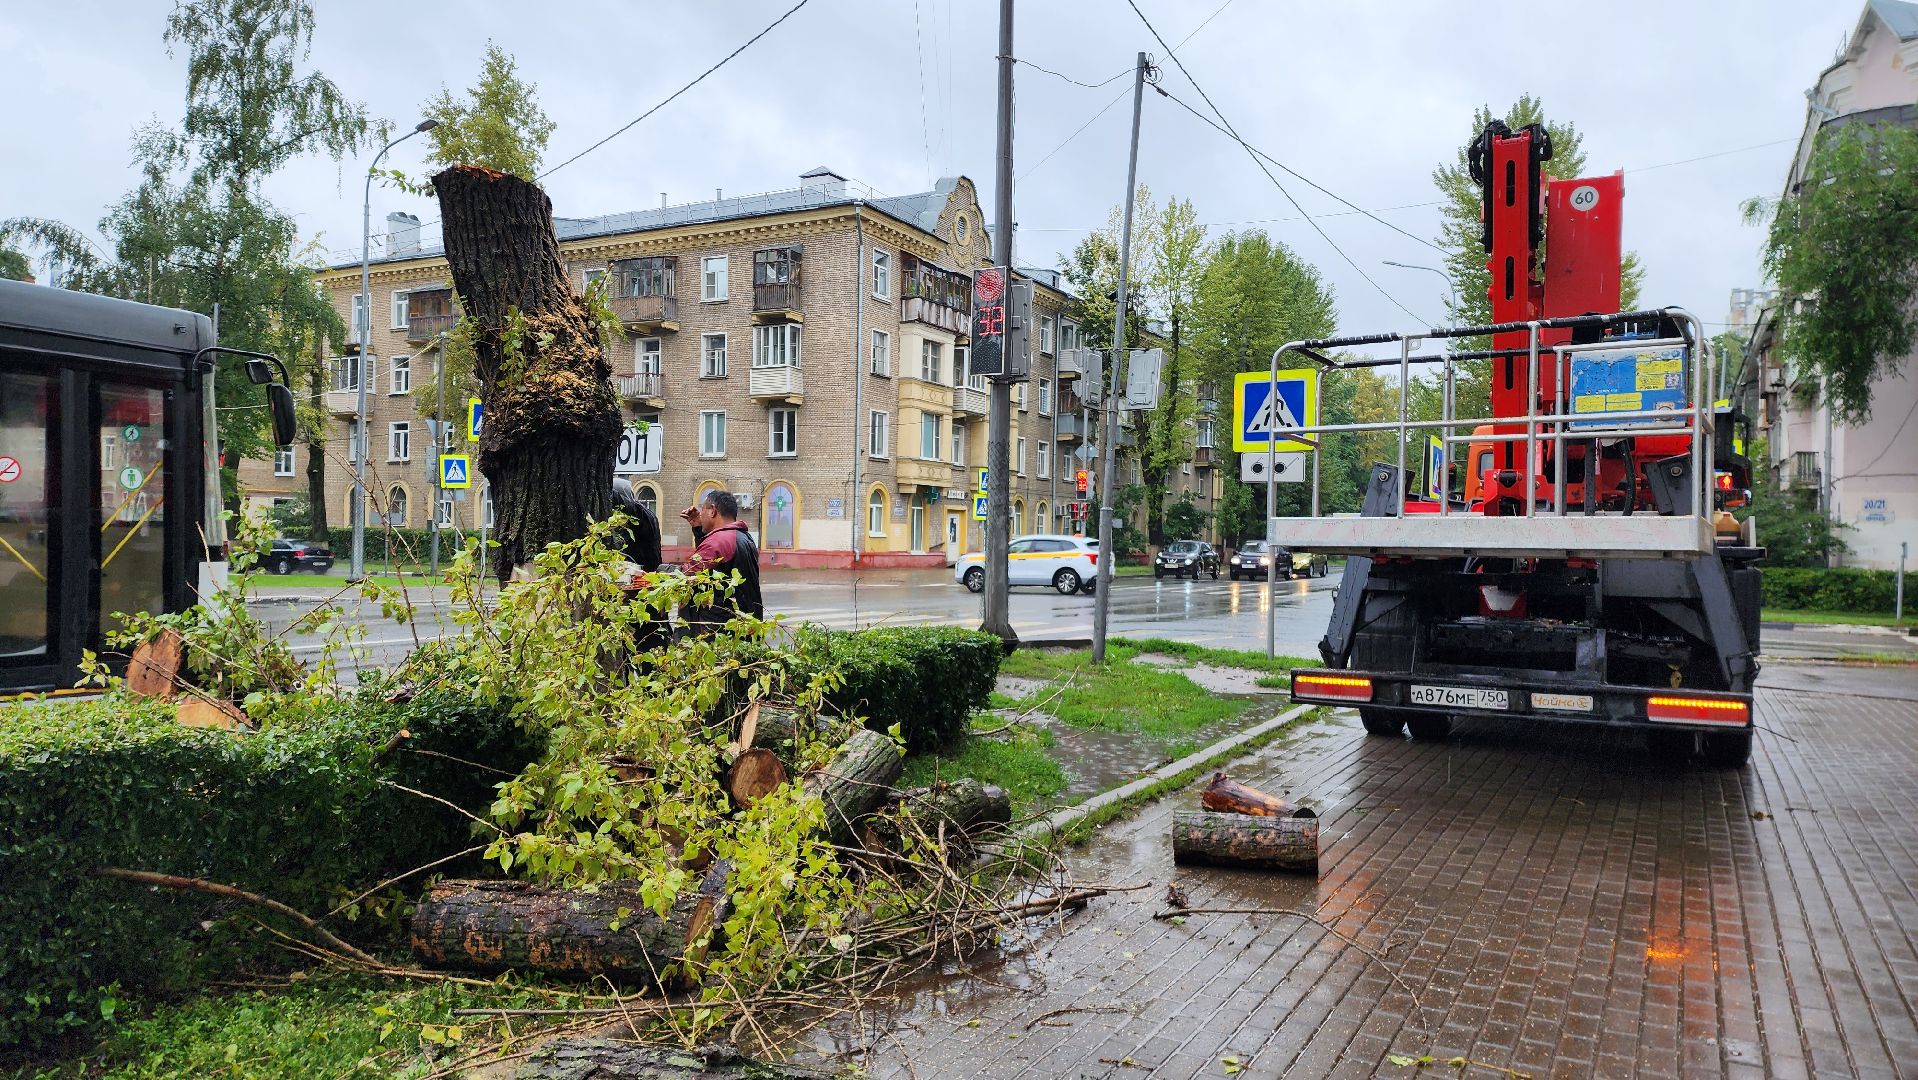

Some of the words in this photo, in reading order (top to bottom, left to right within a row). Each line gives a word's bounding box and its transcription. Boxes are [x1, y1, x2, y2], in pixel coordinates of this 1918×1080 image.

[1575, 191, 1594, 205] 60
[979, 305, 1004, 337] 32
[1864, 499, 1886, 510] 20/21
[1479, 690, 1504, 703] 750
